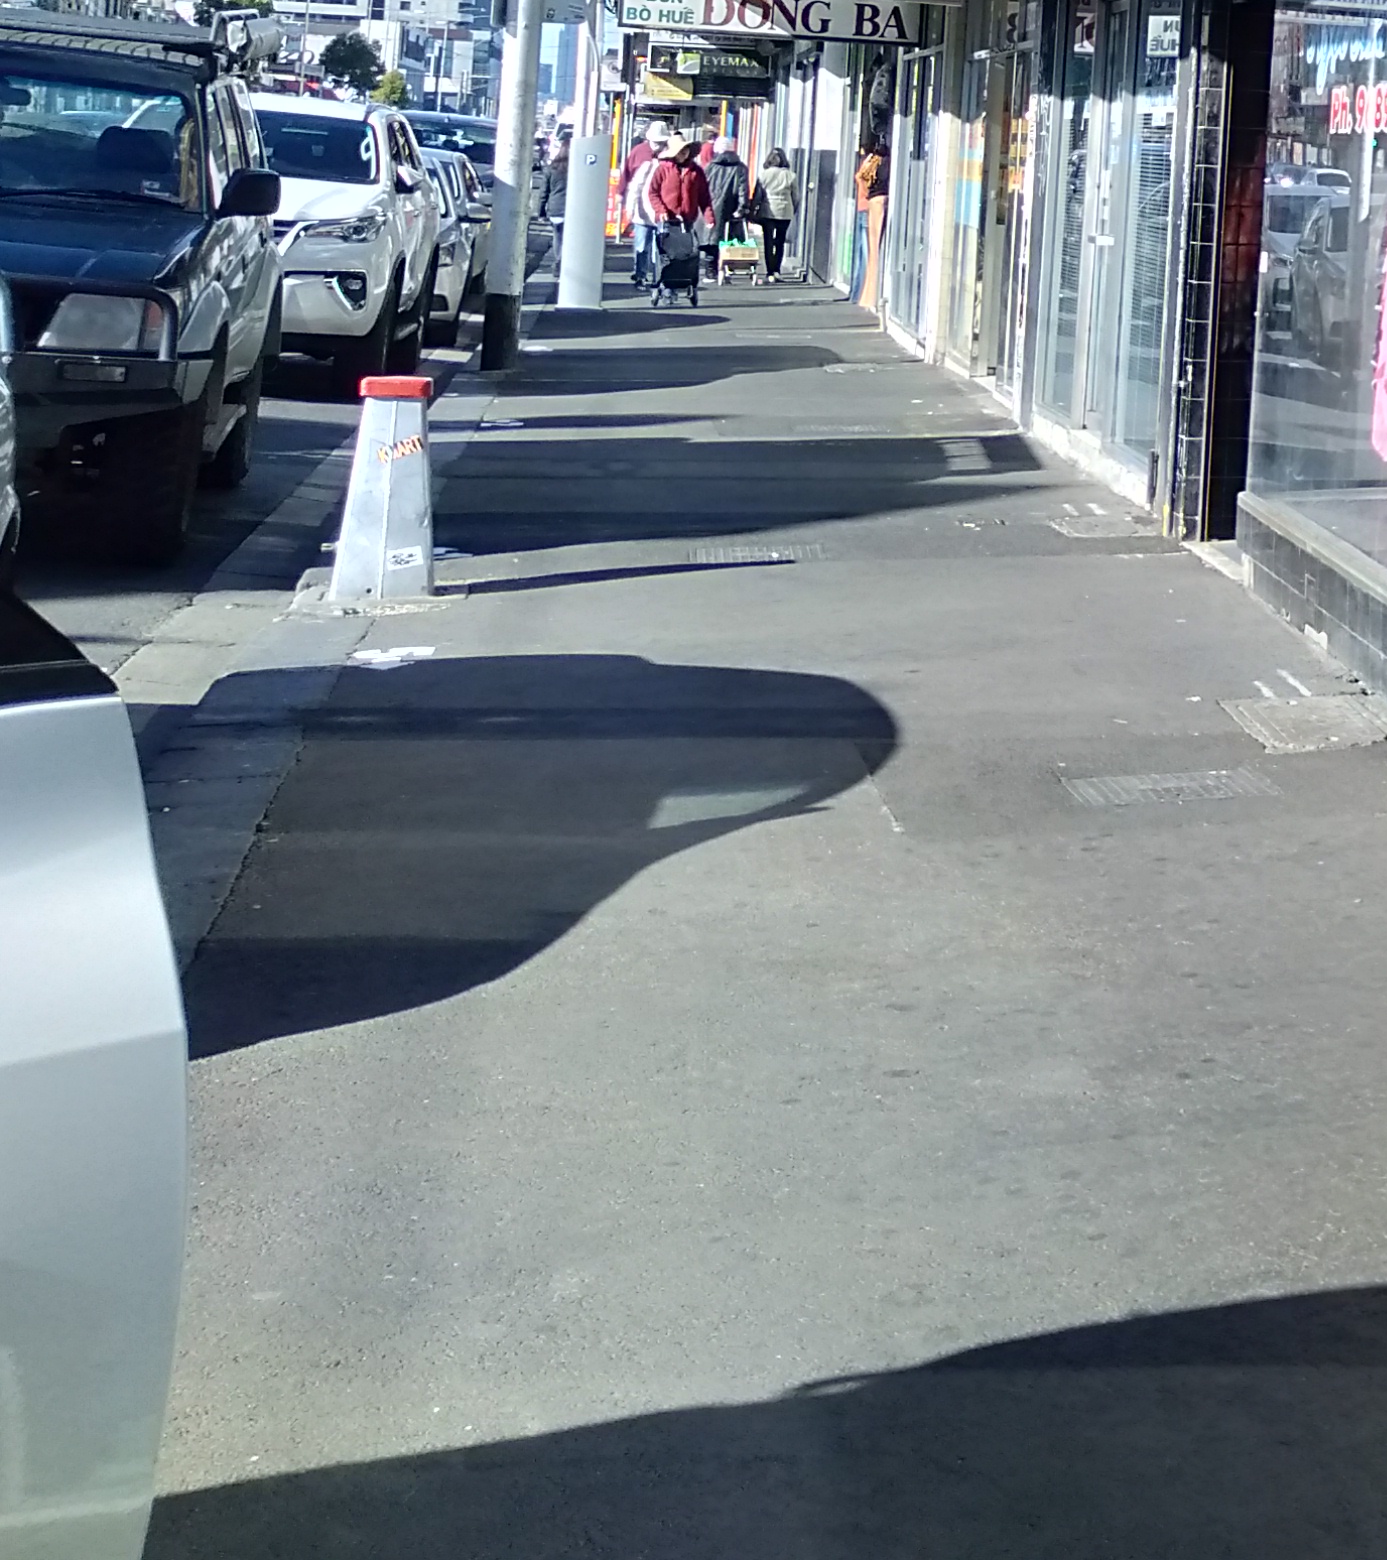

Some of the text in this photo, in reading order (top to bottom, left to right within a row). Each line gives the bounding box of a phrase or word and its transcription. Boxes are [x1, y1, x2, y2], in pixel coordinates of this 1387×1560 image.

[626, 4, 695, 24] BÒ HUẾ
[853, 3, 910, 41] BA
[702, 55, 759, 69] EYEMAX
